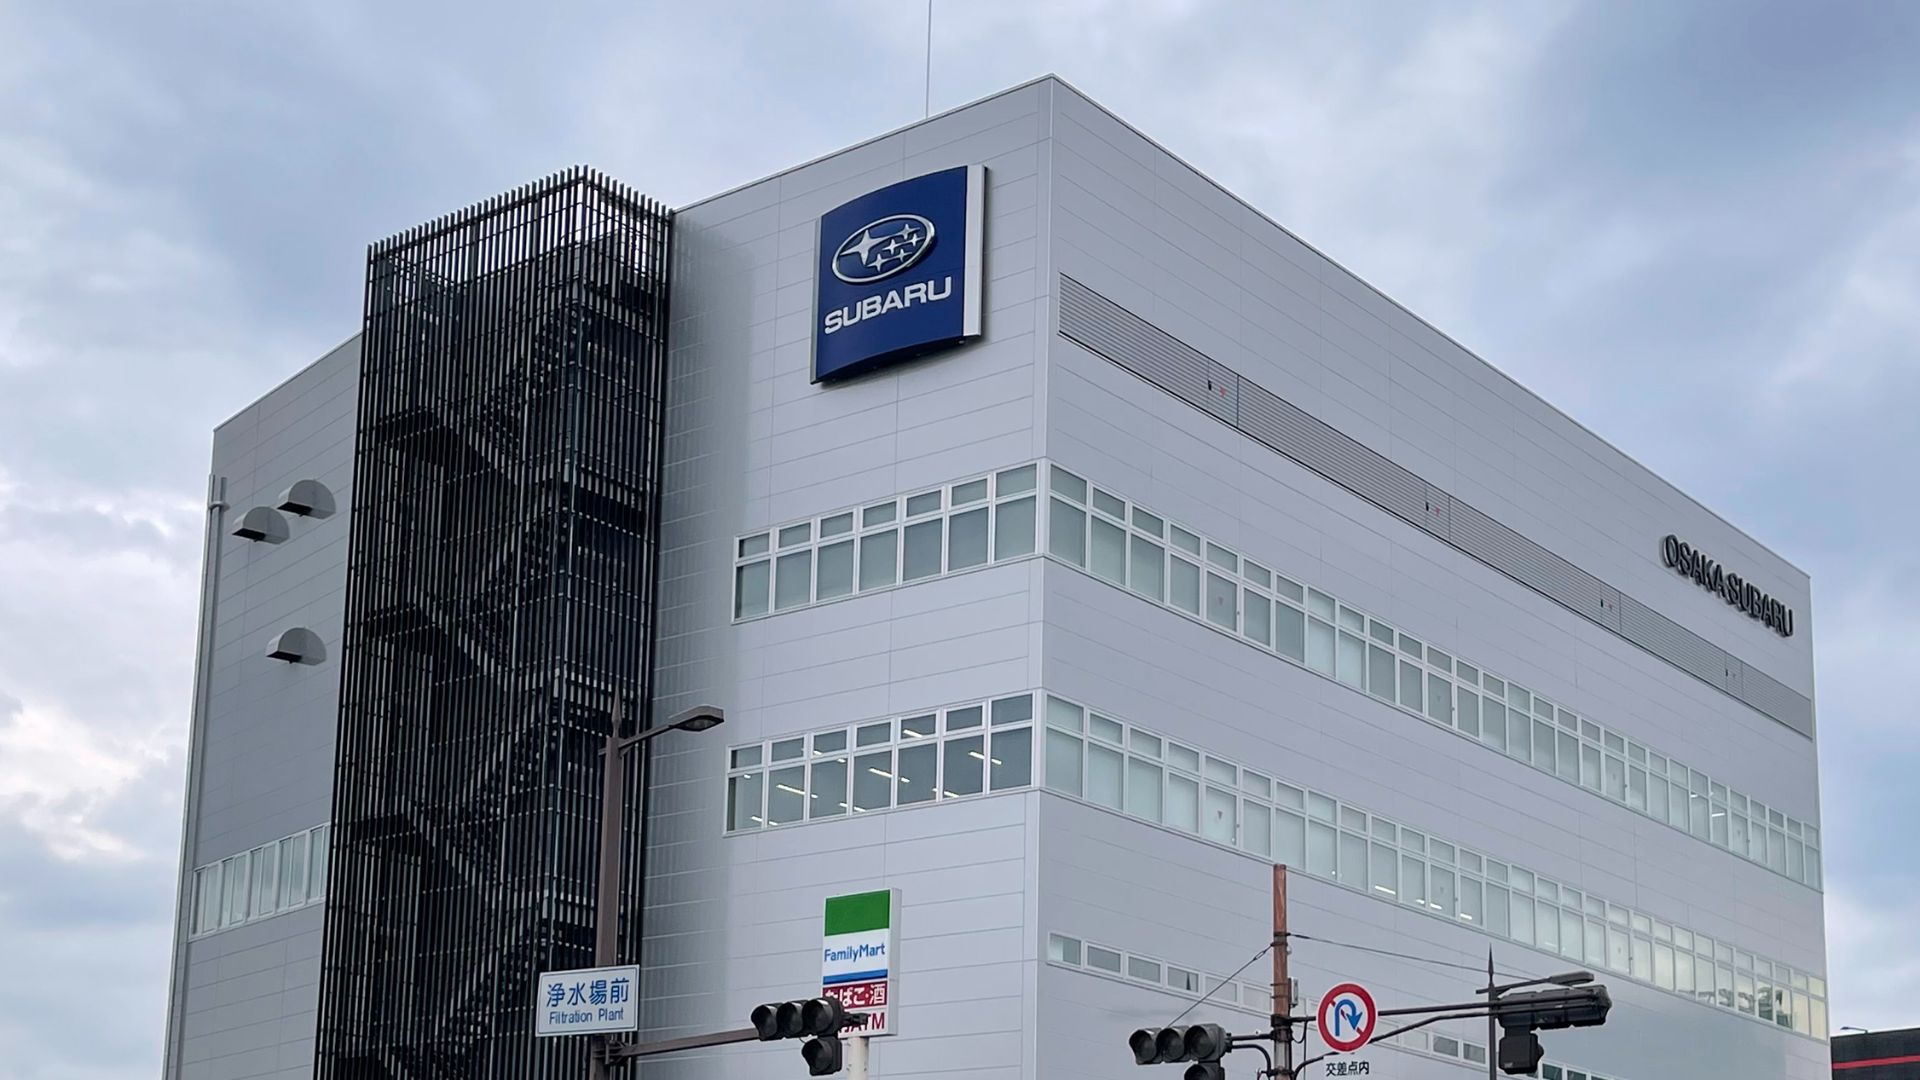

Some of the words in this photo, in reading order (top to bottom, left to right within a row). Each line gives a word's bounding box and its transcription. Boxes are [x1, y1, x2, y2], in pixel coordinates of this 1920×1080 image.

[824, 276, 952, 335] SUBARU
[1663, 534, 1726, 598] OSAKA
[1726, 573, 1794, 638] SUBARU
[824, 943, 886, 963] FamilyMart
[546, 977, 630, 1008] 浄水場前
[549, 1010, 593, 1025] Filtration
[598, 1006, 624, 1021] Plant
[1326, 1060, 1370, 1077] 交差点内
